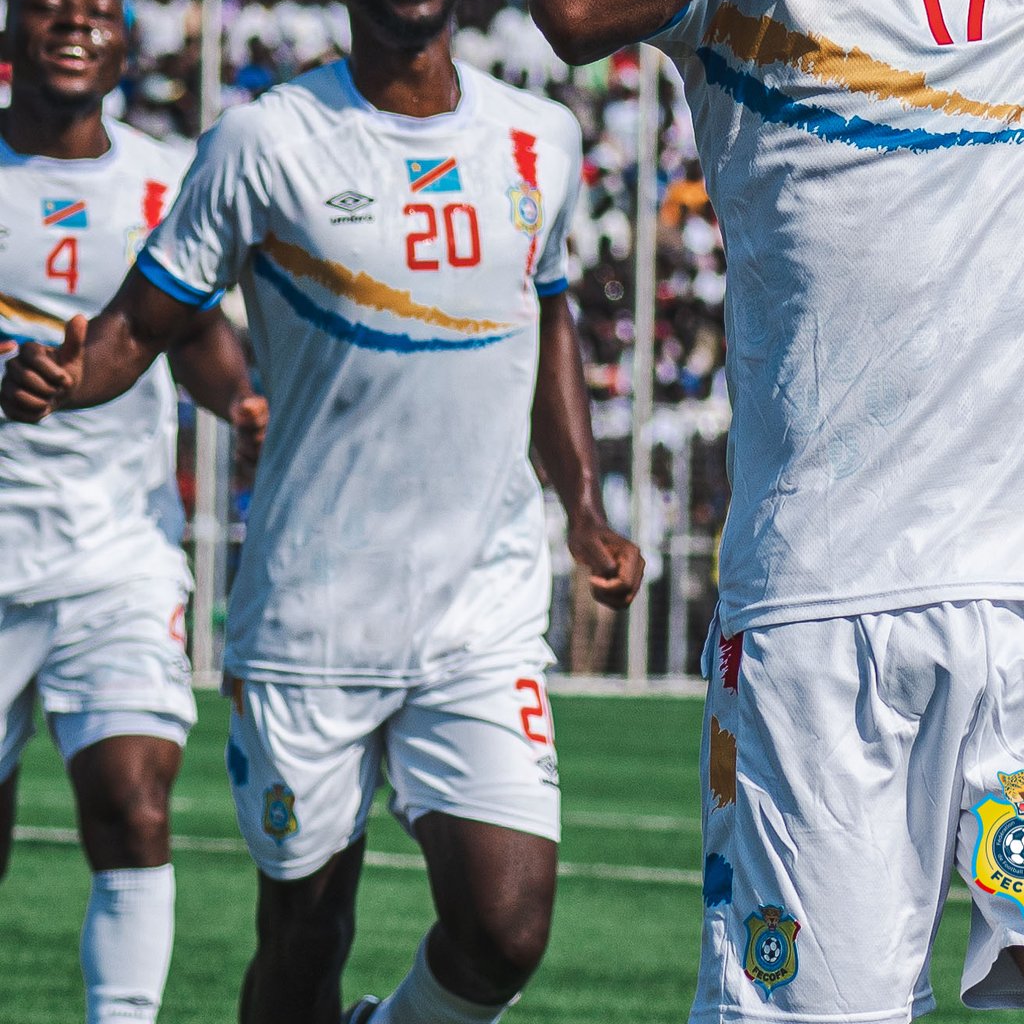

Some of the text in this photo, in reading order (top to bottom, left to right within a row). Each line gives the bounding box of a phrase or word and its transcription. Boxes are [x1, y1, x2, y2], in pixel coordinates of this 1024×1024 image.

[46, 237, 78, 294] 4
[404, 203, 481, 270] 20
[515, 679, 555, 745] 2
